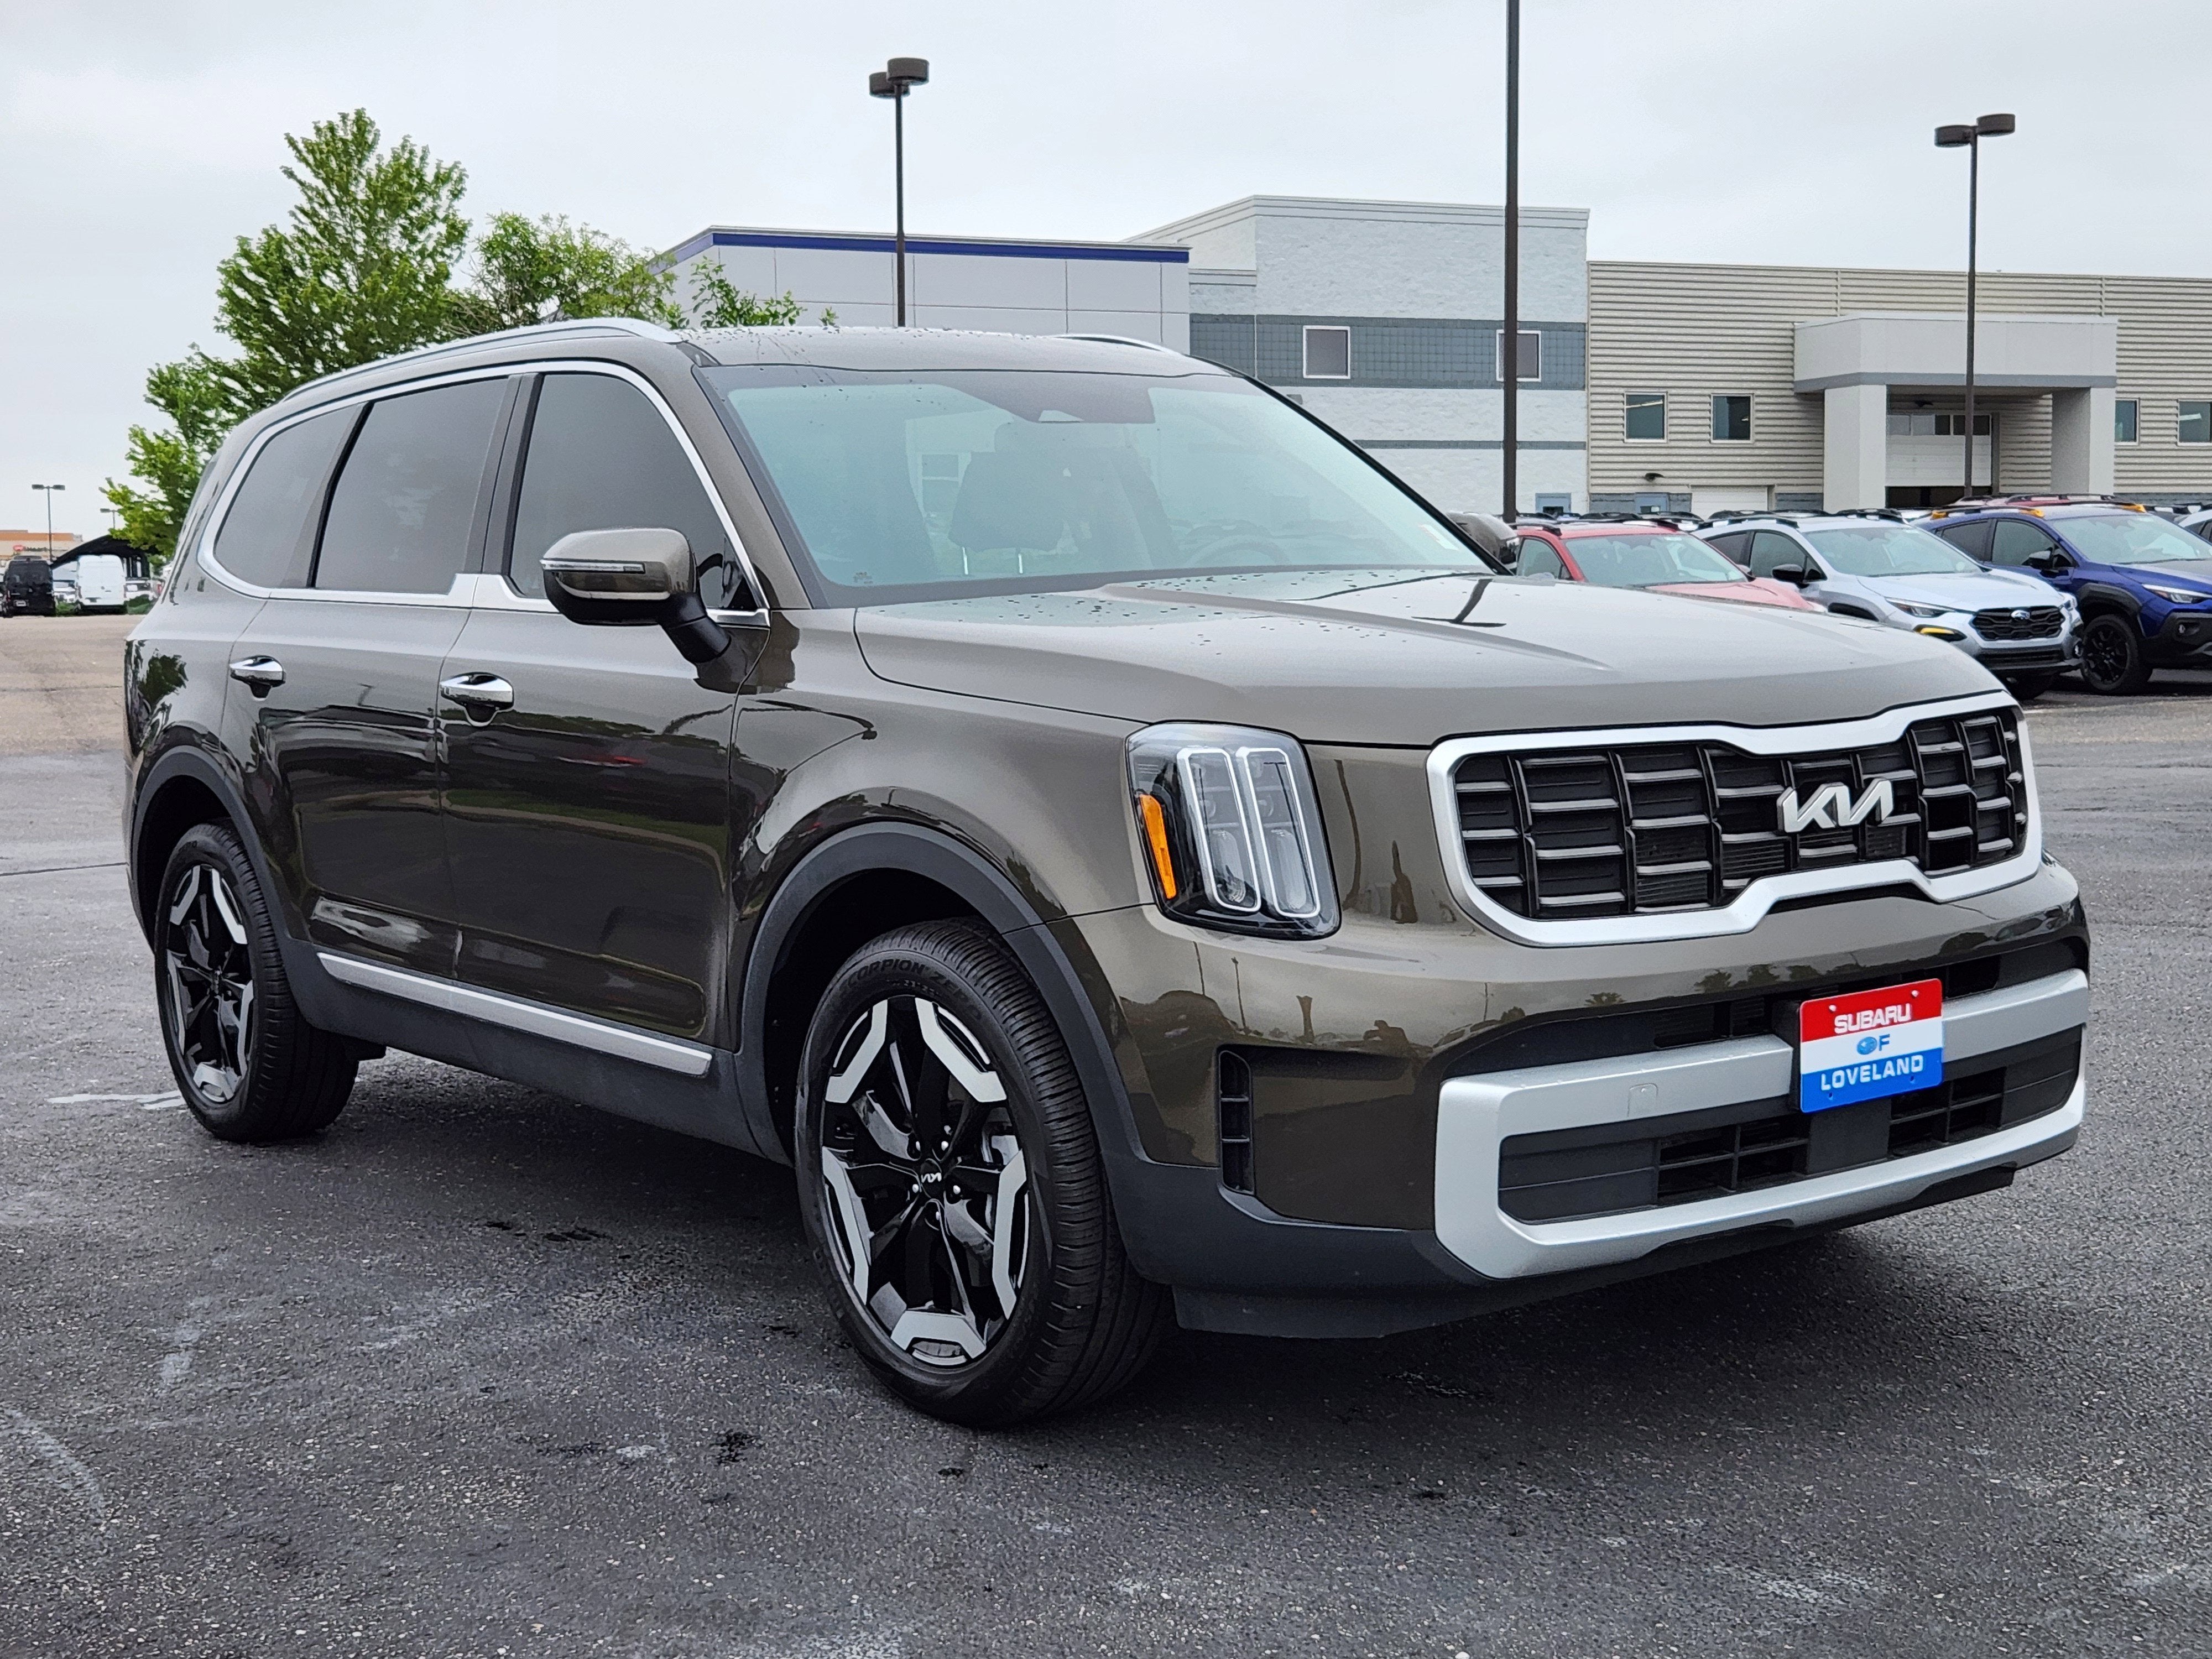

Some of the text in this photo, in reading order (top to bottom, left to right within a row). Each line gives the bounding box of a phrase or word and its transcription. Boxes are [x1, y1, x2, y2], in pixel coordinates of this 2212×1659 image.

[1776, 776, 1893, 833] KIA
[1834, 1003, 1912, 1034] SUBARU
[1856, 1034, 1891, 1056] OF
[1820, 1054, 1924, 1091] LOVELAND
